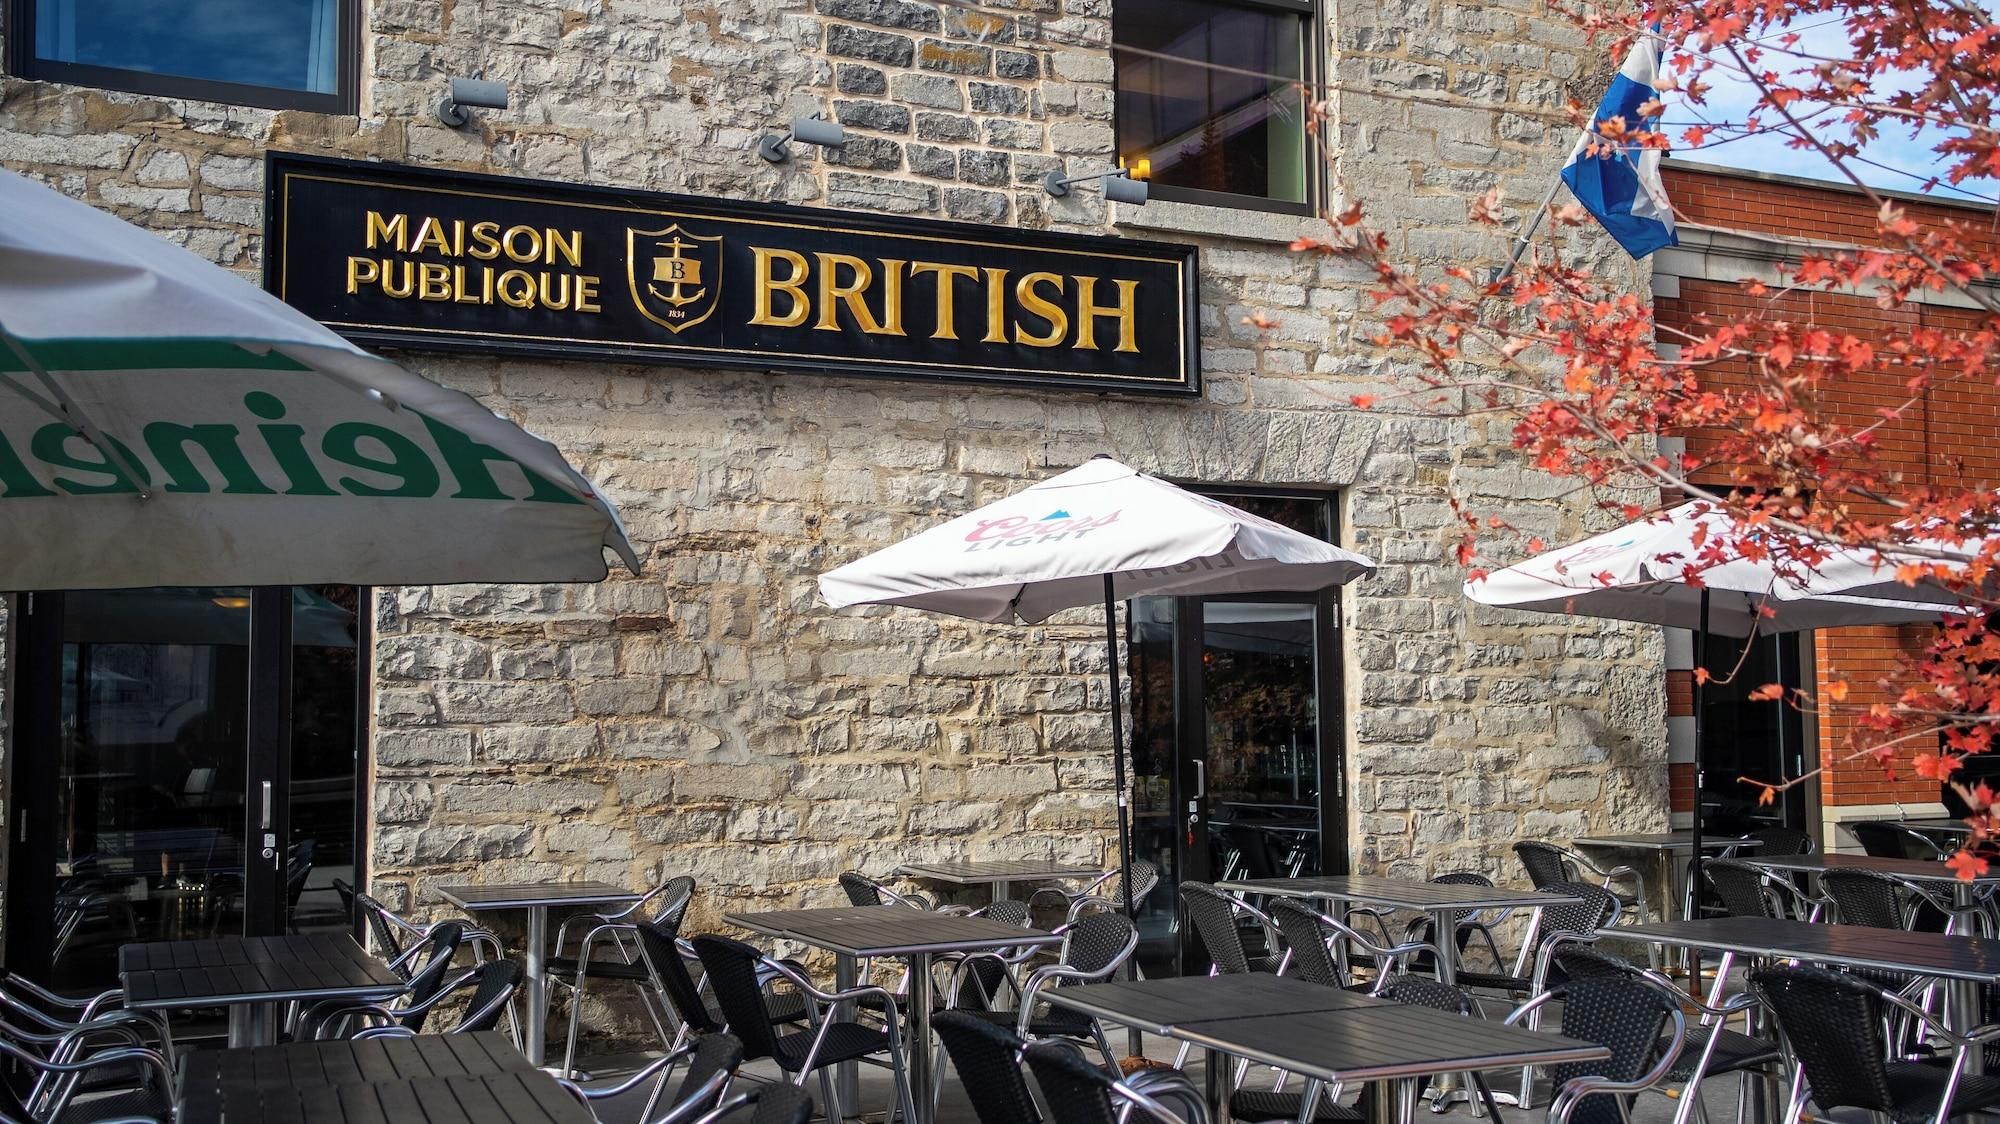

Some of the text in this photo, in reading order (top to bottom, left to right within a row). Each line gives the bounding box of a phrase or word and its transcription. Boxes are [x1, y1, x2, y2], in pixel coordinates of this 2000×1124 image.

[366, 210, 583, 268] MAISON
[347, 255, 601, 313] PUBLIQUE
[670, 261, 686, 279] B
[668, 309, 686, 319] 1834
[746, 246, 1141, 354] BRITISH
[964, 528, 1096, 552] LIGHT
[965, 509, 1123, 542] Coors
